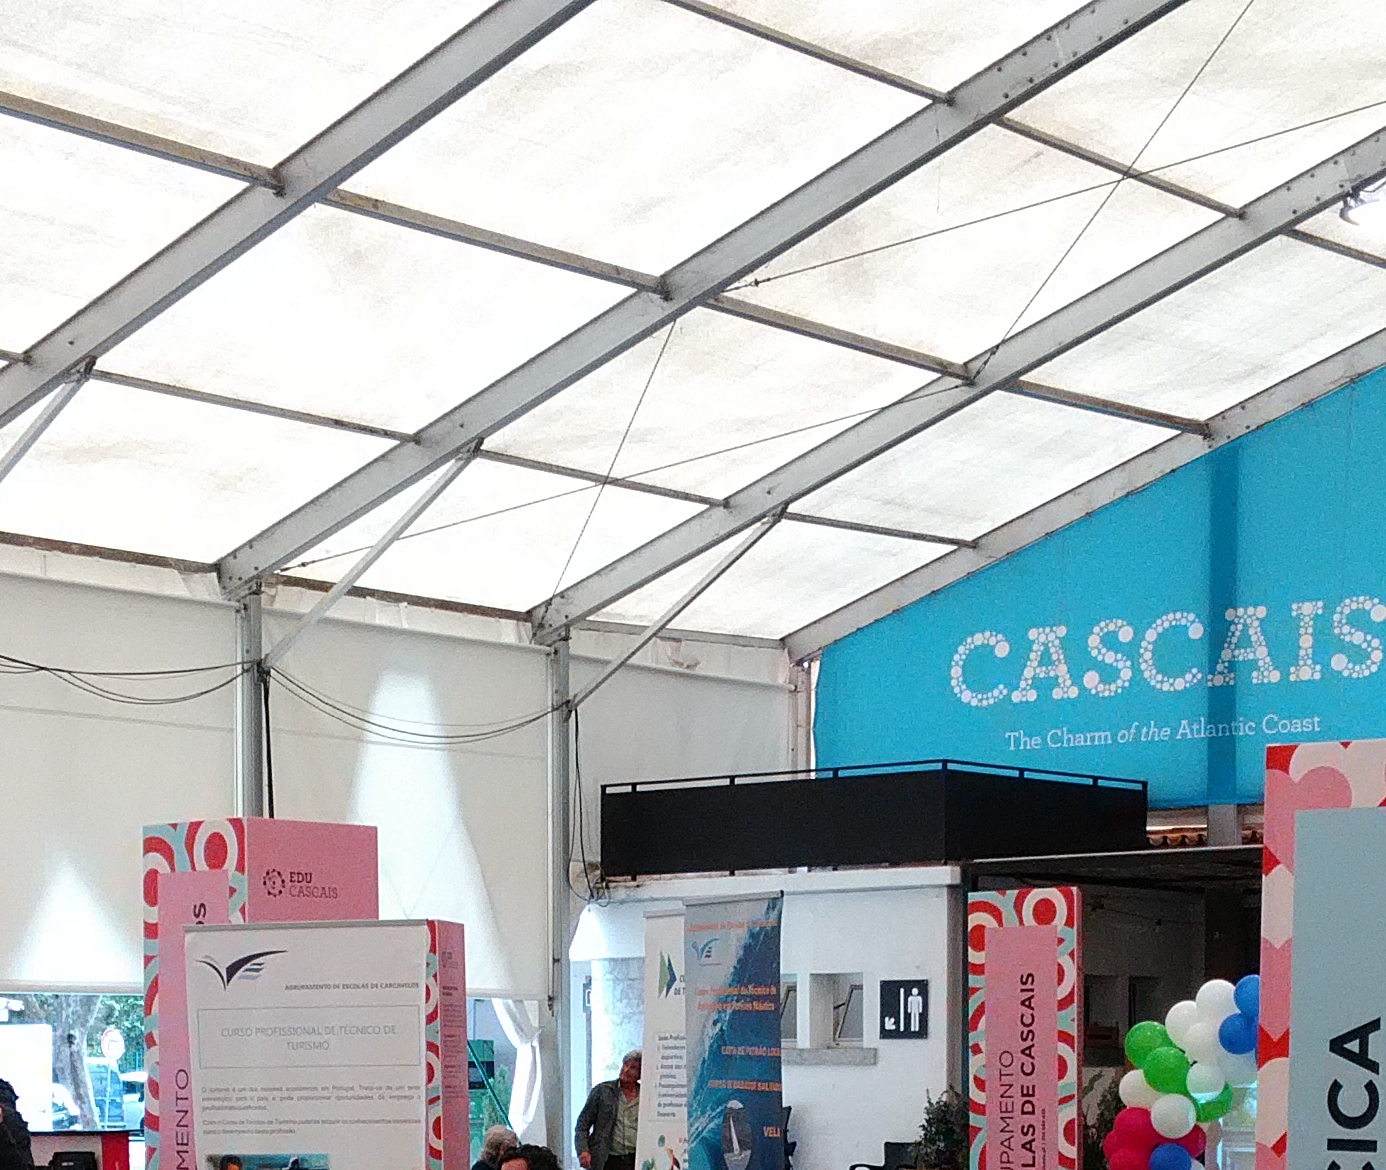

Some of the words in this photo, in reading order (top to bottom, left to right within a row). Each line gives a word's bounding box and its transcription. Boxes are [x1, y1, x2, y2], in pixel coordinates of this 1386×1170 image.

[1005, 730, 1042, 752] The
[1047, 726, 1112, 748] Charm
[1117, 722, 1140, 743] of
[1141, 721, 1170, 742] the
[1175, 717, 1256, 740] Atlantic
[1262, 713, 1322, 734] Coast
[289, 871, 313, 884] EDU
[289, 885, 338, 900] CASCAIS
[221, 1026, 253, 1038] CURSO
[255, 1026, 322, 1037] PROFISSIONAL
[324, 1026, 335, 1036] DE
[338, 1023, 381, 1035] TÉCNICO
[383, 1024, 396, 1035] DE
[1020, 971, 1036, 1082] CASCAIS
[286, 1040, 330, 1051] TURISMO
[1020, 1084, 1036, 1116] DE
[763, 1125, 781, 1138] VELA
